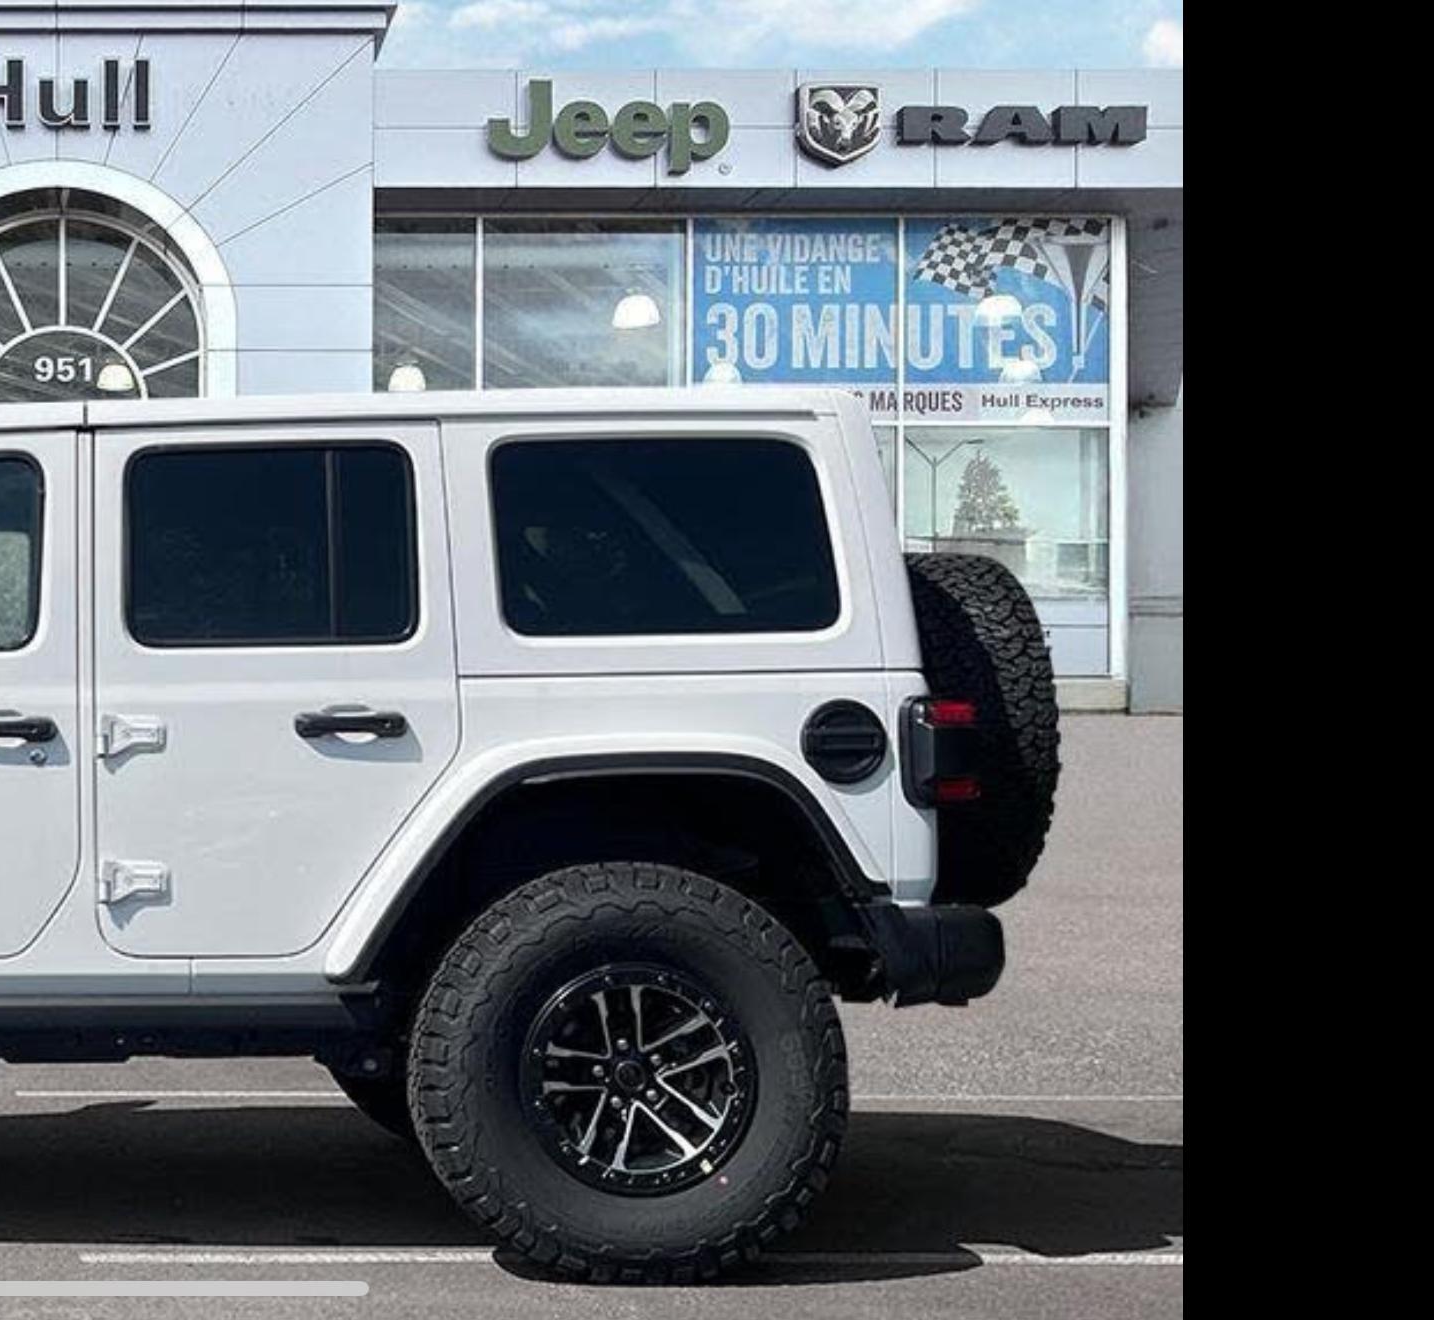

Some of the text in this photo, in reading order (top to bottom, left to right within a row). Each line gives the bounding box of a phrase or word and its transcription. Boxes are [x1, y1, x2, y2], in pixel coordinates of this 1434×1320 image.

[487, 79, 730, 176] Jeep
[895, 106, 1148, 146] RAM
[704, 234, 881, 263] UNE VIDANGE
[704, 266, 852, 294] D'HUILE EN
[706, 304, 1058, 369] 30 MINUTES
[34, 356, 92, 382] 951
[869, 390, 963, 413] MARQUES
[981, 394, 1104, 410] Hull Express
